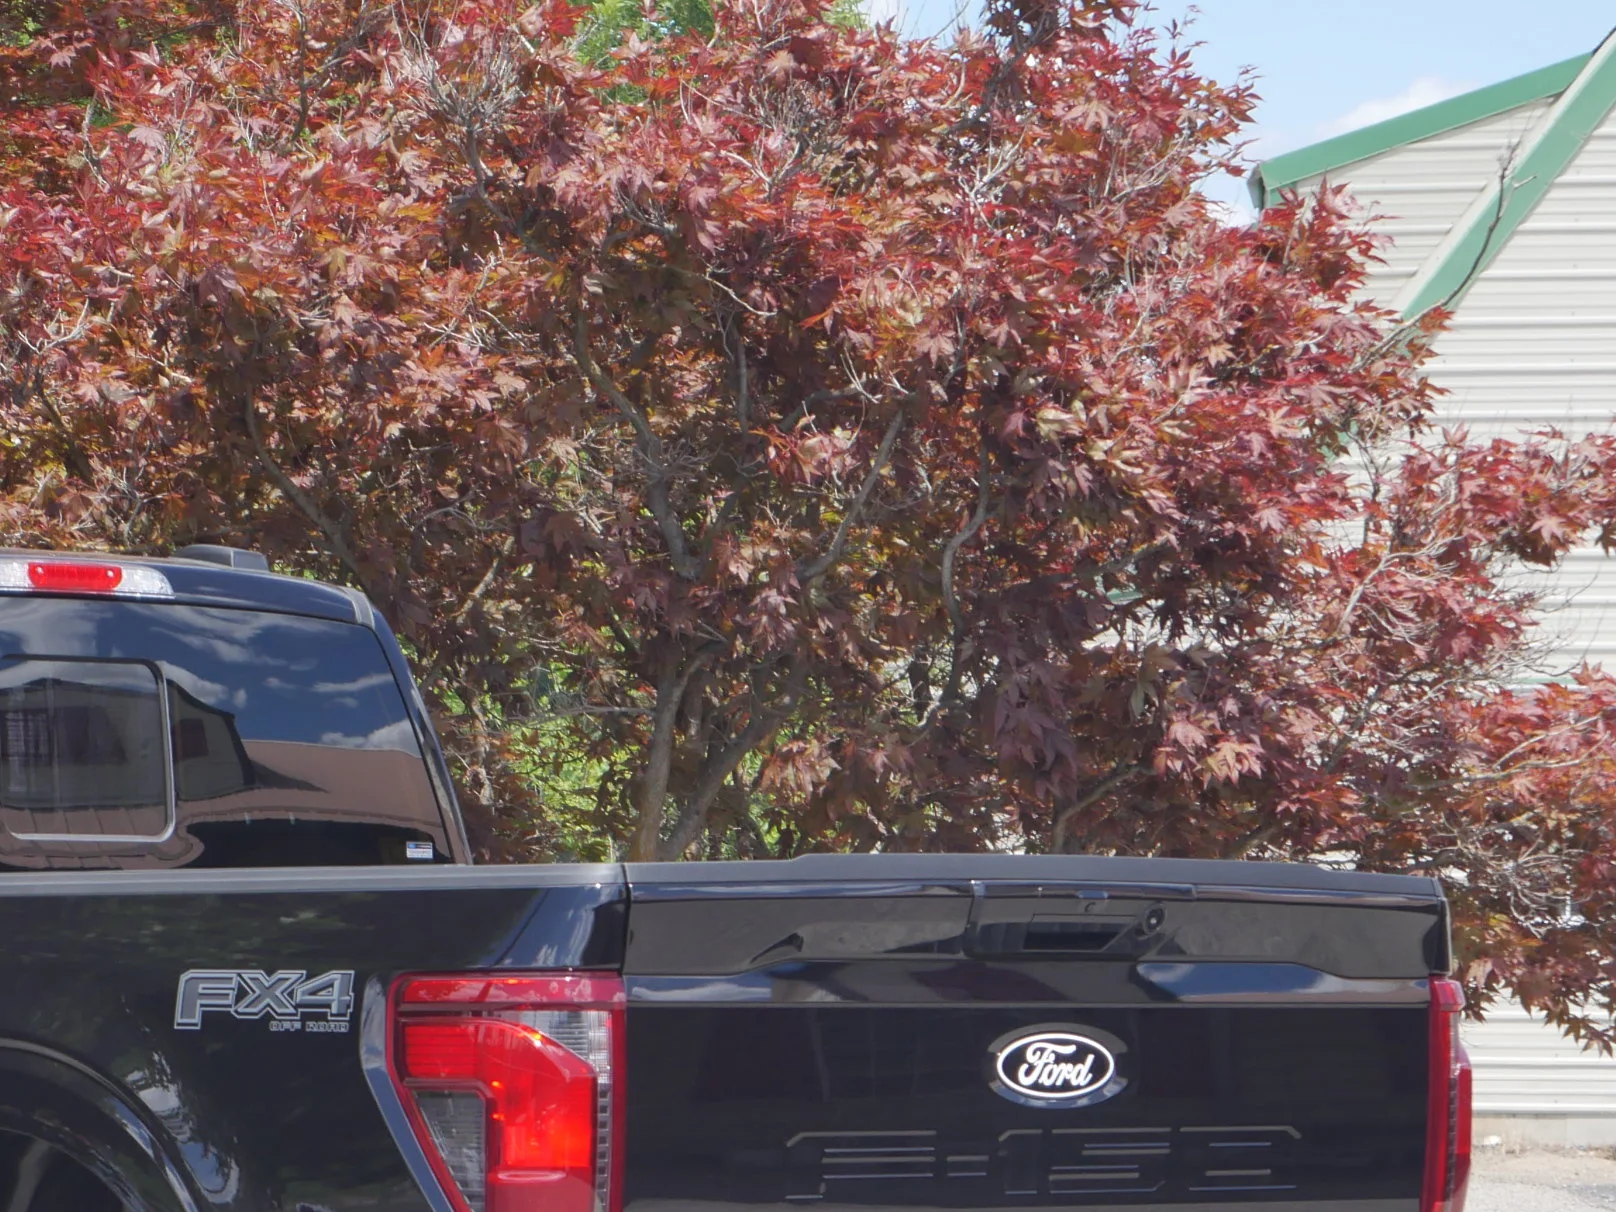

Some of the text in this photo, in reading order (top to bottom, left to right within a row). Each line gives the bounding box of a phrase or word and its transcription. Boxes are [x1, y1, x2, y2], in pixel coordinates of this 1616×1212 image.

[174, 969, 355, 1029] FX4
[269, 1020, 350, 1032] OFF ROAD
[1017, 1040, 1096, 1087] Ford
